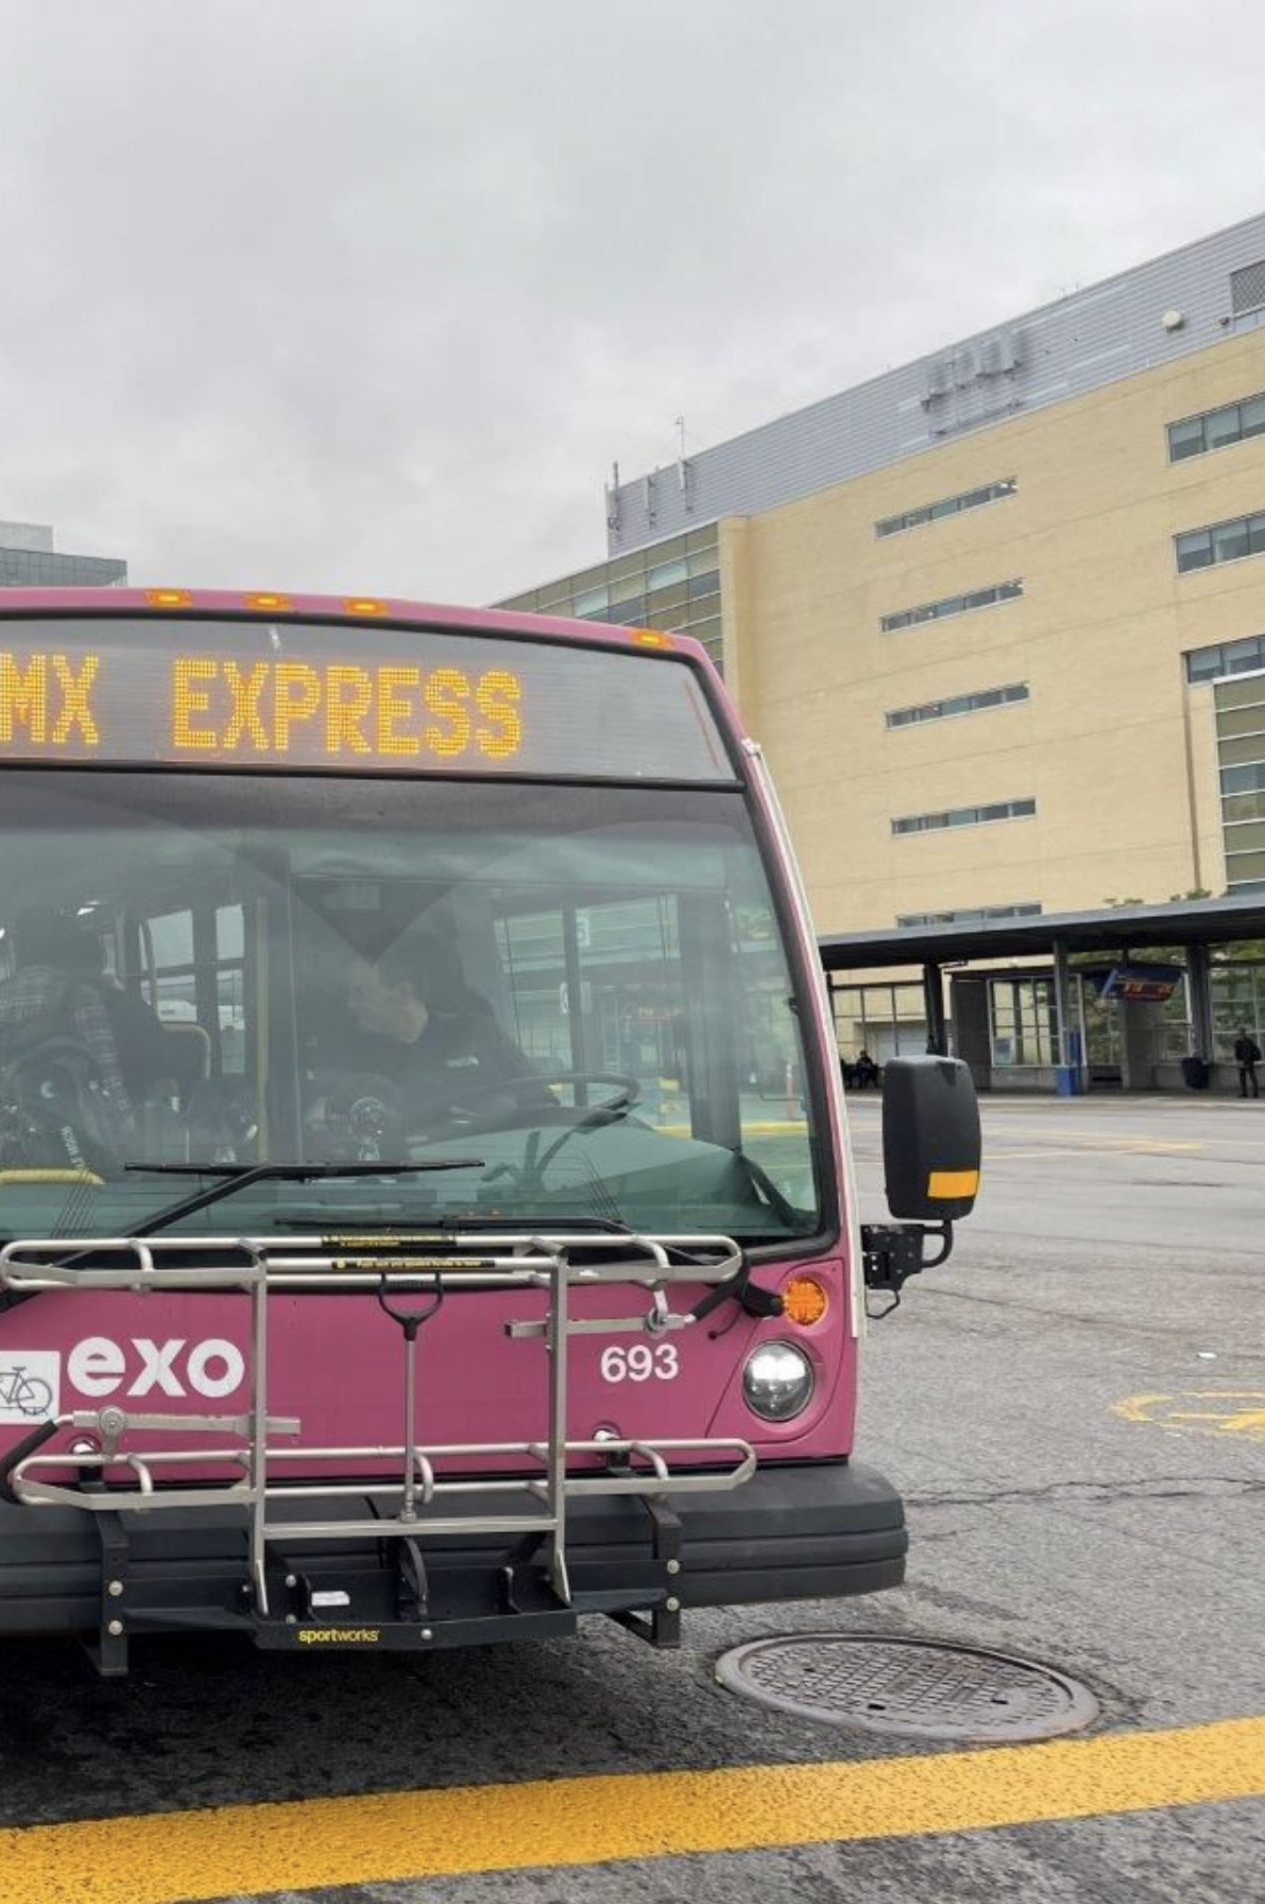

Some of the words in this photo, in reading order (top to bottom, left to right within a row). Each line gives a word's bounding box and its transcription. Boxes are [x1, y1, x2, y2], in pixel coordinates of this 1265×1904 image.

[174, 658, 522, 758] EXPRESS
[67, 1336, 245, 1398] exo
[601, 1343, 679, 1383] 693
[298, 1628, 378, 1644] sportworks
